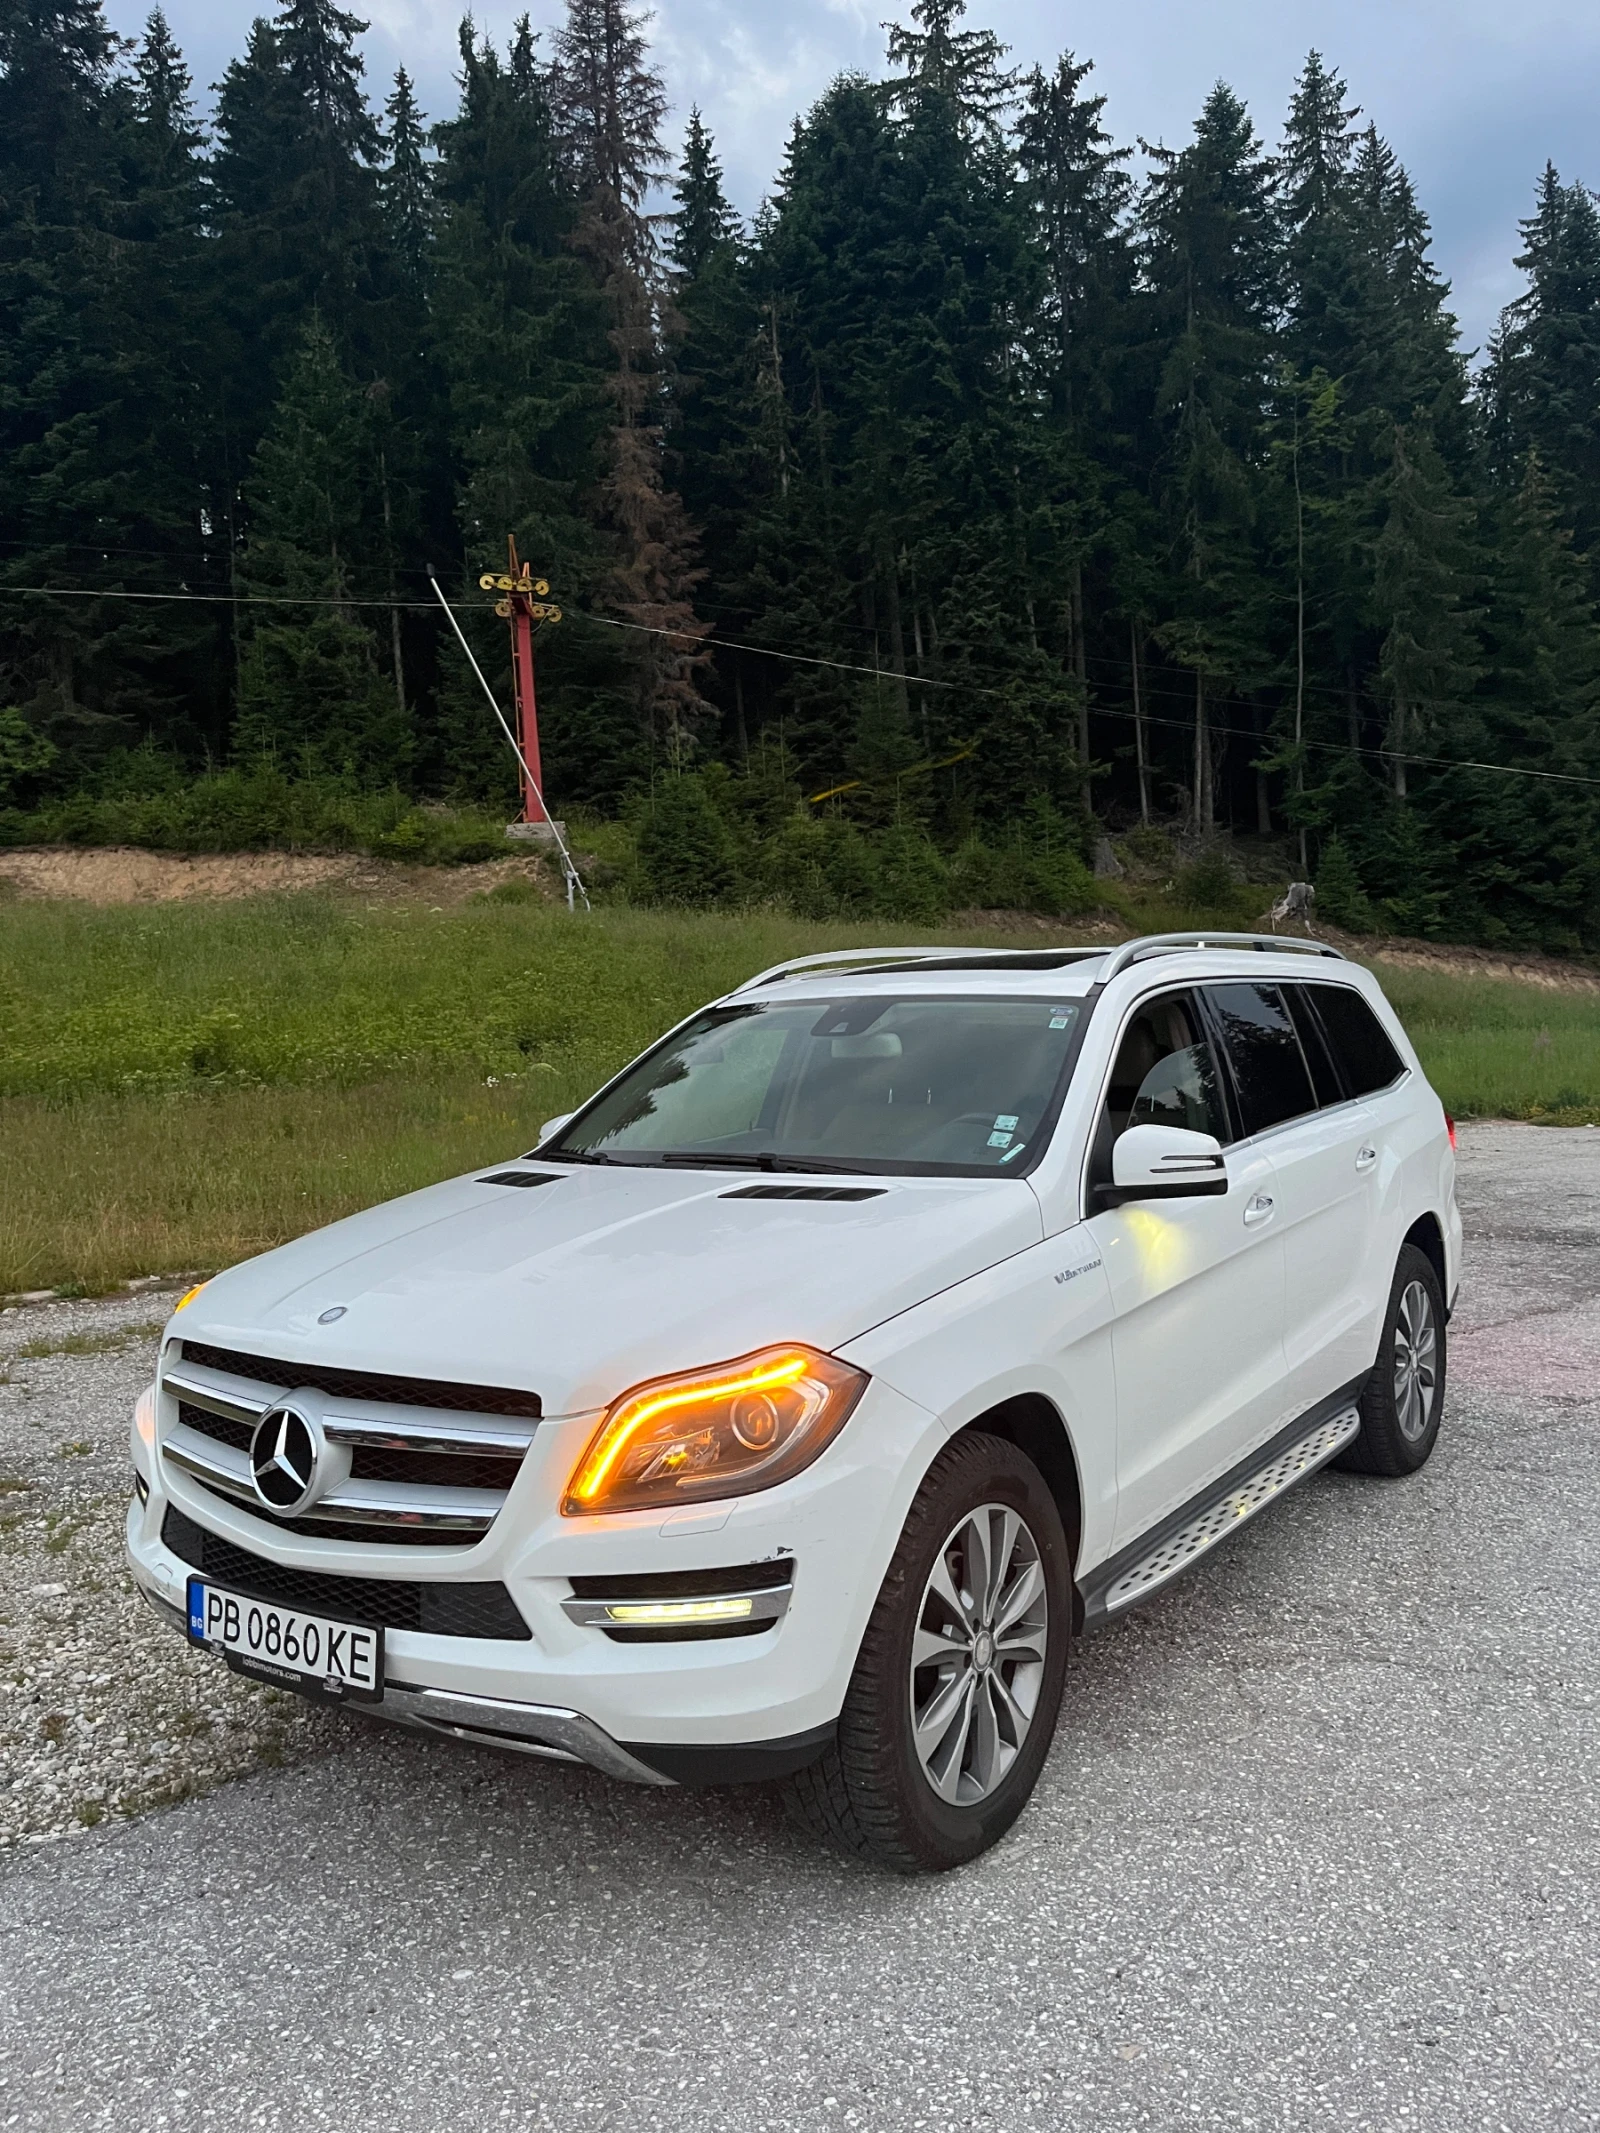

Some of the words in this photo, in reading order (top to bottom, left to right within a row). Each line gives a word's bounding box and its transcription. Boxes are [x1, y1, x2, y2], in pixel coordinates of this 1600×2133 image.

[191, 1615, 203, 1629] BG
[207, 1592, 241, 1643] PB
[247, 1607, 320, 1667] 0860
[327, 1626, 371, 1683] KE
